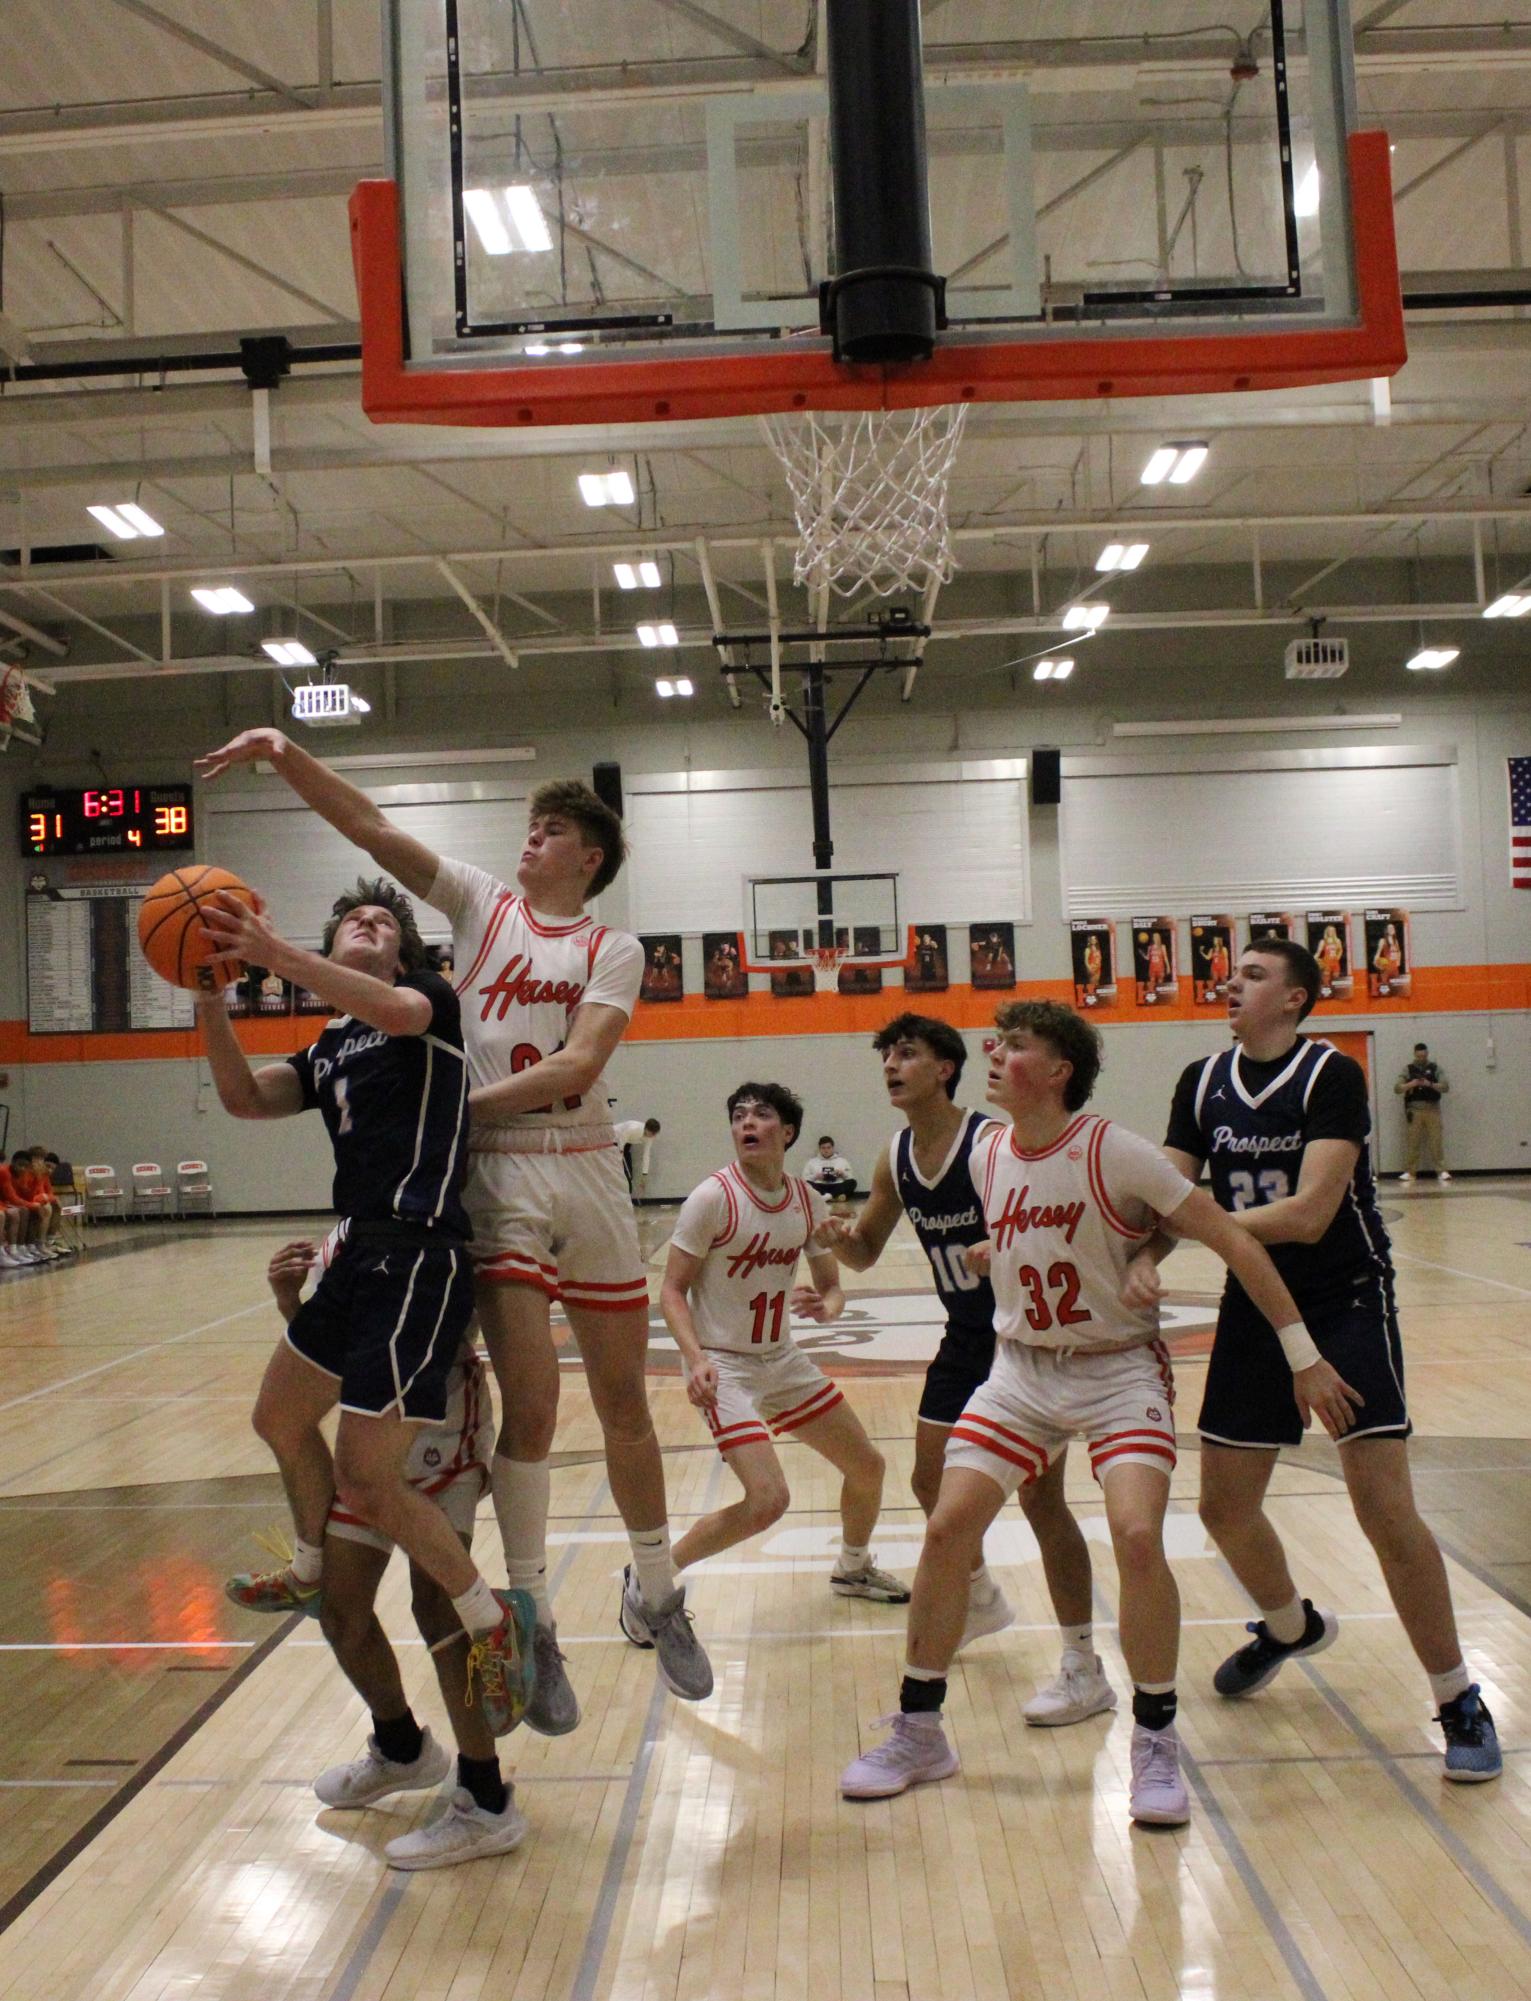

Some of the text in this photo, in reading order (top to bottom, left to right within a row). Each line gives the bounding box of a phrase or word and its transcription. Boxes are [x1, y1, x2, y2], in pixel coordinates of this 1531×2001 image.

[83, 789, 140, 818] 6:31
[154, 806, 188, 835] 38
[30, 813, 62, 841] 31
[89, 829, 141, 848] period 4
[80, 887, 139, 897] BASKETBALL
[479, 953, 586, 1022] Hersey
[334, 1075, 353, 1136] 1
[1212, 1125, 1302, 1160] Prospect
[909, 1206, 978, 1236] Prospect
[991, 1185, 1086, 1252] Hersey
[930, 1243, 980, 1293] 10
[1019, 1261, 1093, 1332] 32
[749, 1290, 786, 1344] 11
